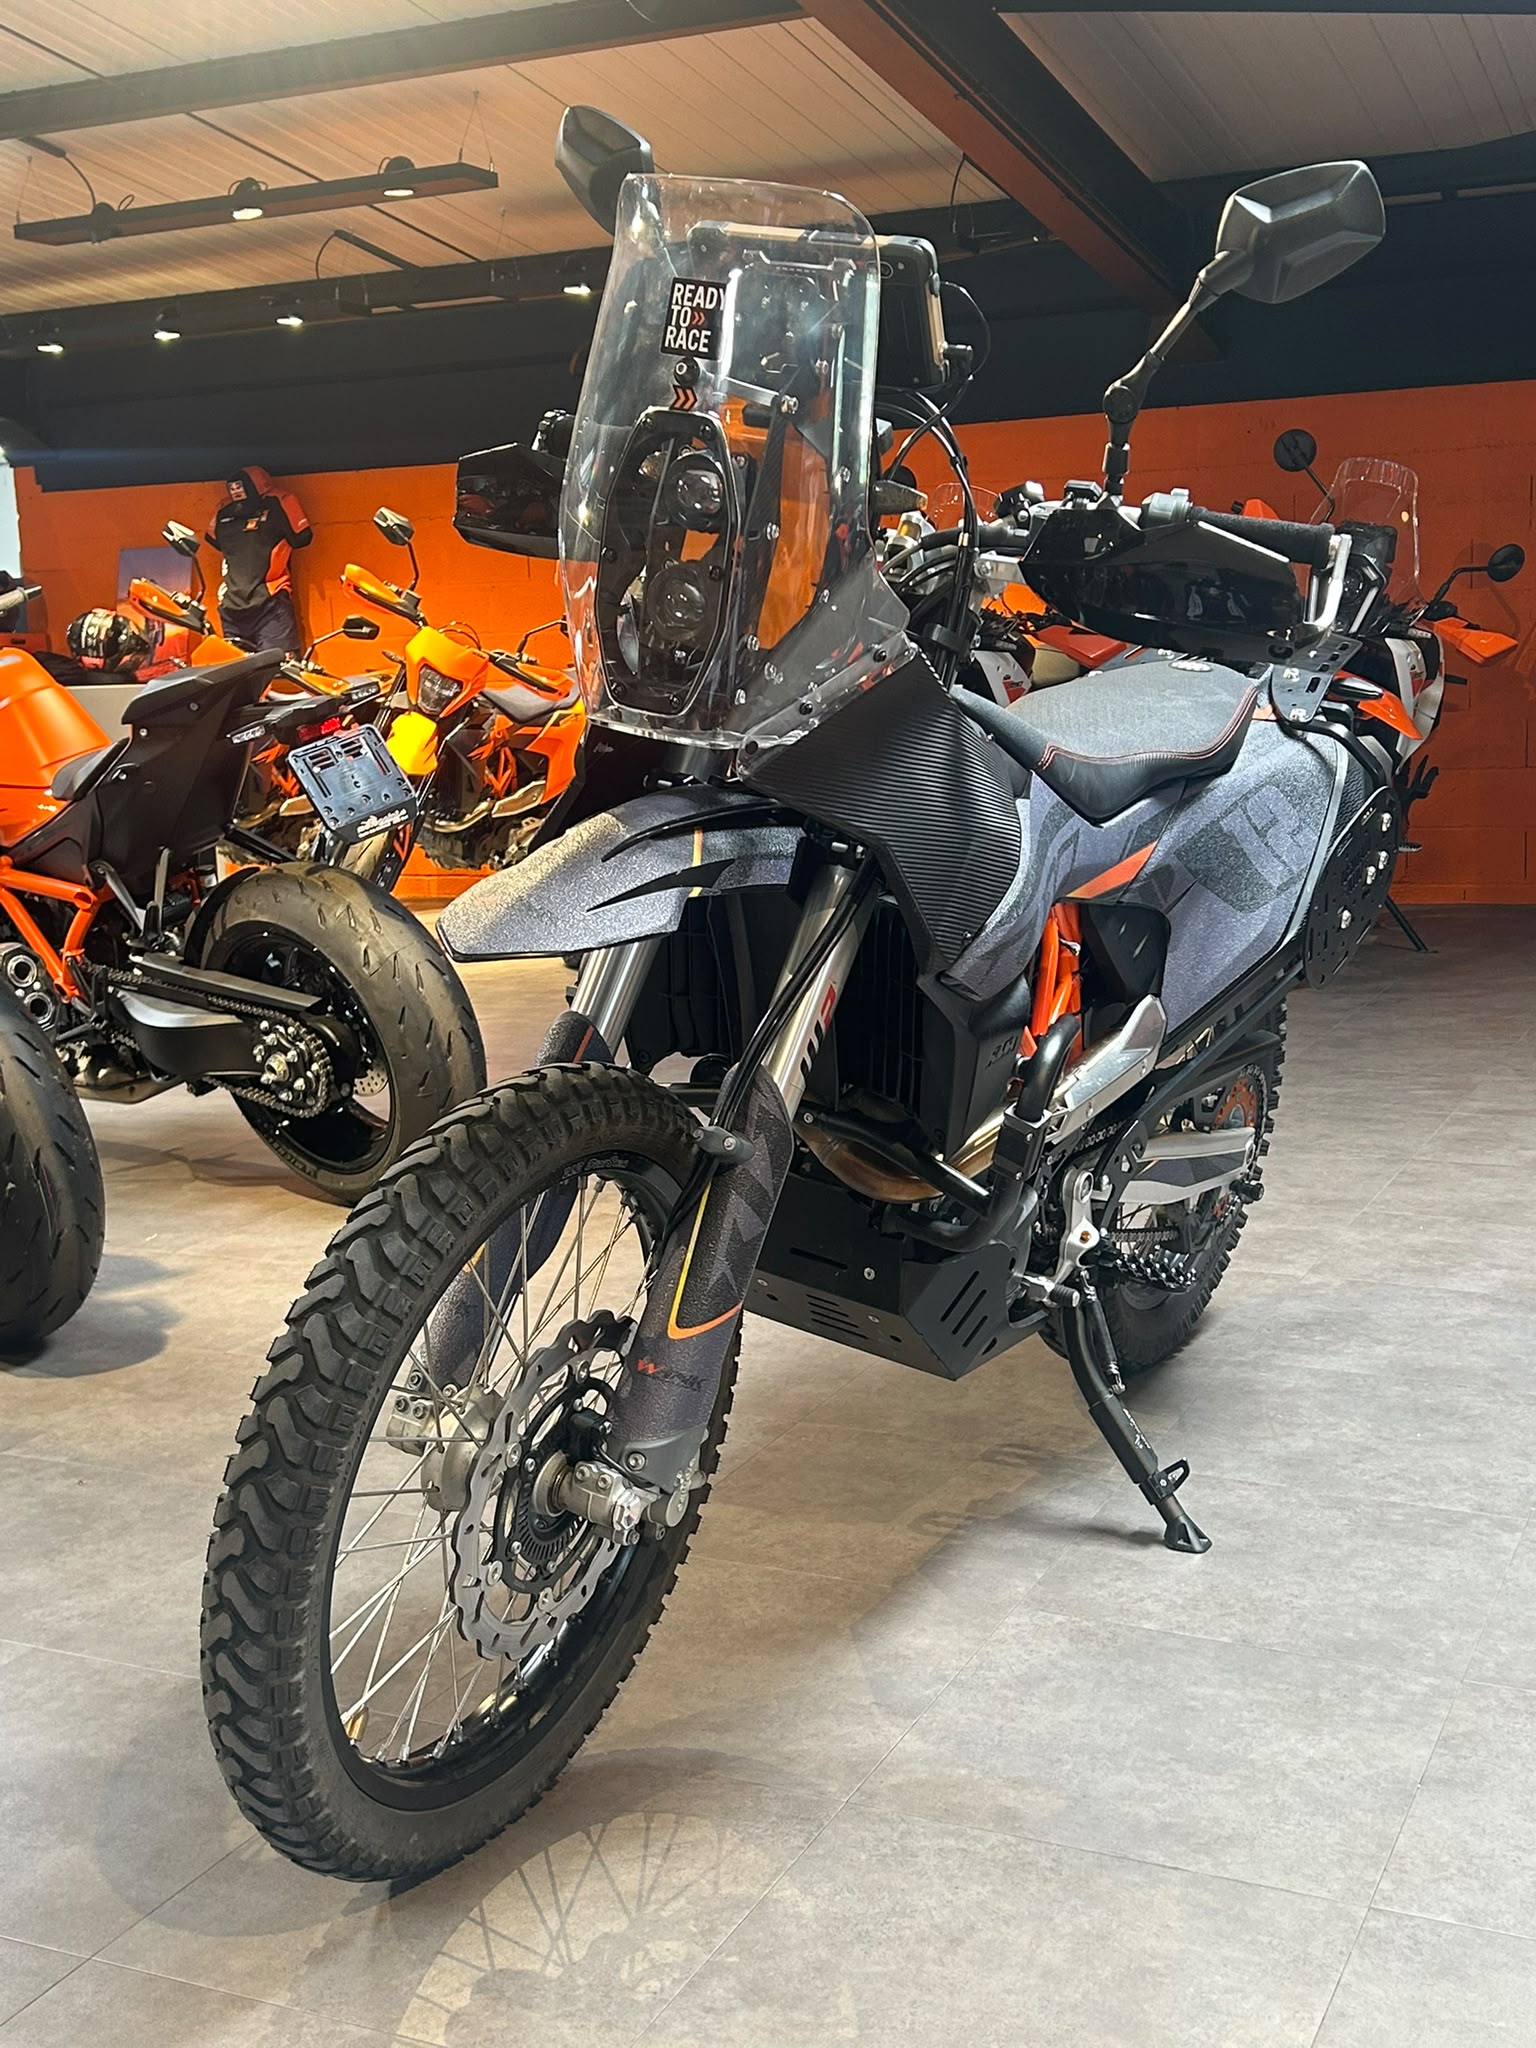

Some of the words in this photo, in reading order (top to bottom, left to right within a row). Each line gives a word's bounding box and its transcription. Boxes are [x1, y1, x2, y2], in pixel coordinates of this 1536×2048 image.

[672, 283, 726, 311] READY
[671, 305, 692, 327] TO
[664, 325, 712, 353] RACE
